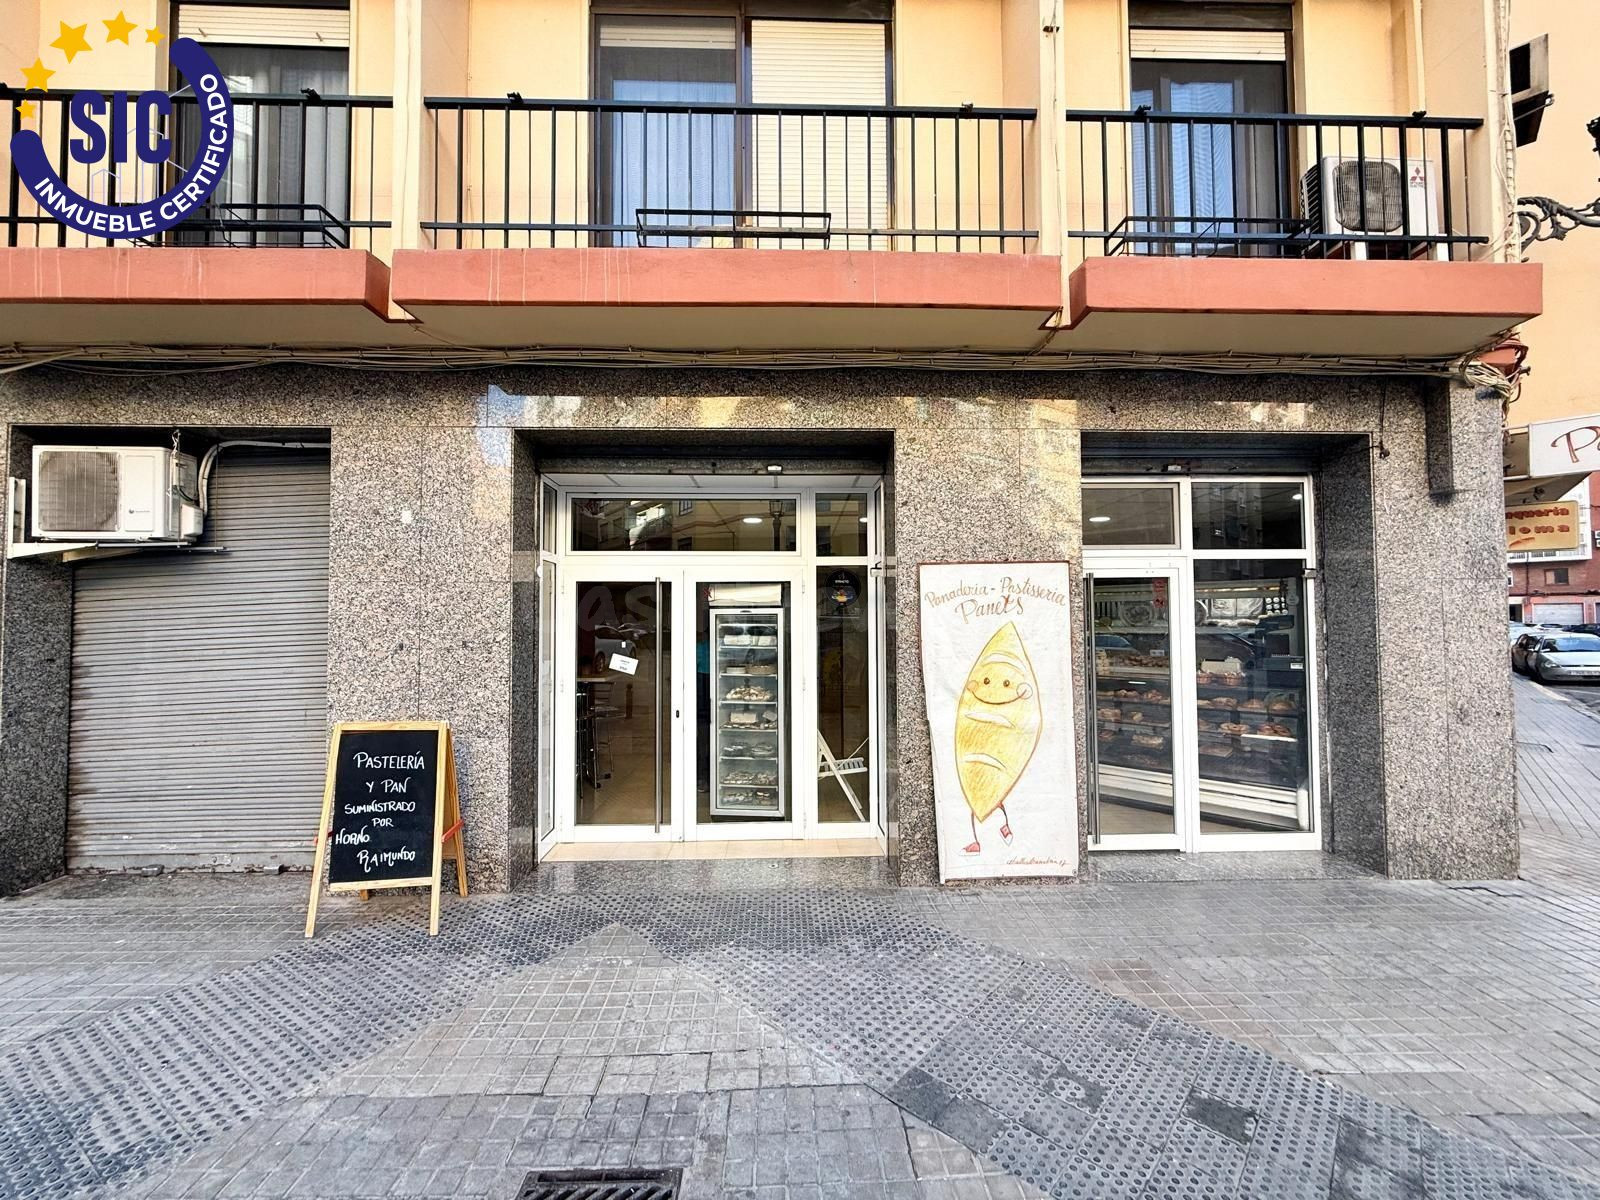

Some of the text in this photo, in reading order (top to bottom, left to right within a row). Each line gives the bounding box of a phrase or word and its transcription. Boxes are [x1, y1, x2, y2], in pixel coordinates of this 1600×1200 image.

[1551, 426, 1600, 463] P
[381, 777, 410, 793] PAN
[344, 800, 416, 815] SUMINISTRADO
[372, 817, 394, 827] POR
[335, 825, 371, 845] HORNO
[356, 845, 416, 873] RAIMUNDO
